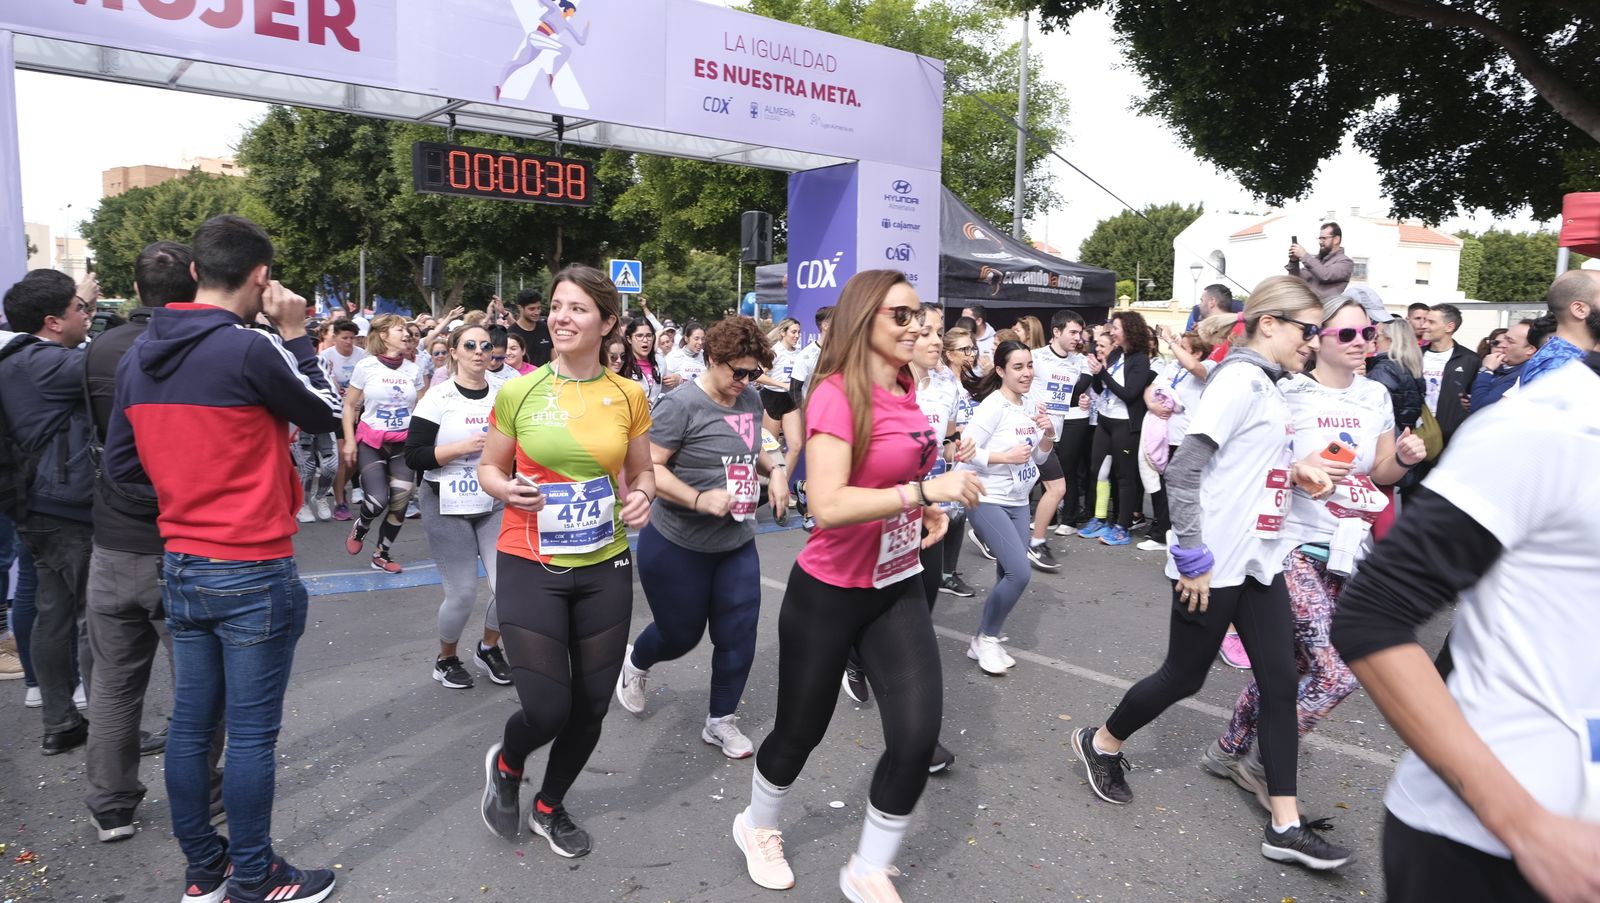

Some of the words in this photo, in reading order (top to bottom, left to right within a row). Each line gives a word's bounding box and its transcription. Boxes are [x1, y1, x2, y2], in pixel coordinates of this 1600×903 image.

[724, 31, 746, 54] LA
[751, 38, 838, 73] IGUALDAD
[694, 57, 719, 80] ES
[723, 63, 807, 98] NUESTRA
[811, 81, 862, 107] META.
[702, 97, 734, 115] CDX
[449, 150, 586, 200] 00:00:38
[884, 194, 920, 205] HYUNDAI
[892, 220, 921, 231] cajamar
[796, 252, 844, 290] CDX
[1051, 374, 1071, 382] MUJER
[1052, 391, 1066, 401] 348
[383, 418, 404, 428] 145
[1317, 417, 1361, 429] MUJER
[1015, 426, 1037, 436] MUJER
[1018, 466, 1037, 482] 1038
[449, 480, 479, 494] 100
[557, 499, 601, 523] 474
[564, 521, 575, 529] ISA
[582, 519, 598, 527] LARA
[613, 558, 630, 569] FILA
